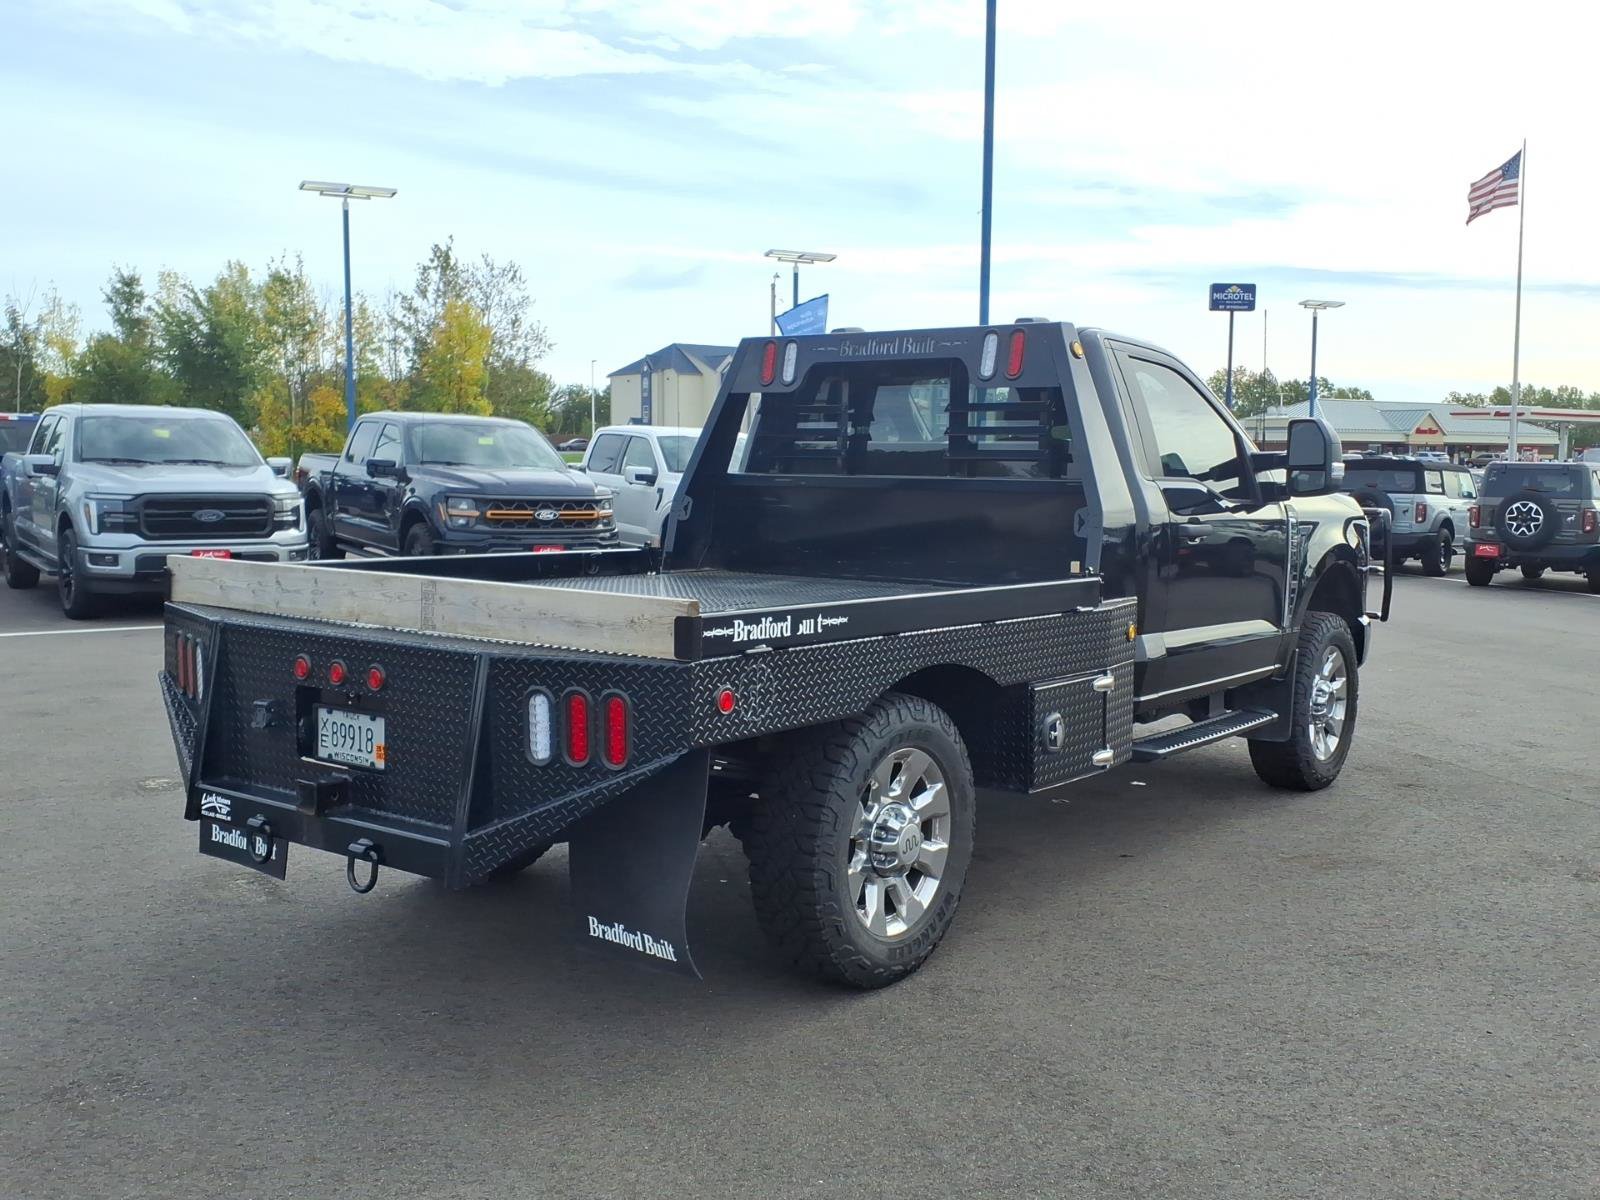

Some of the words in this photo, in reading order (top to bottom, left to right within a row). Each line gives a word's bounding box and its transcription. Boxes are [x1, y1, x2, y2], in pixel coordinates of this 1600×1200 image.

[1213, 292, 1254, 301] MICROTEL
[839, 337, 899, 357] Bradford
[902, 336, 936, 354] Built
[732, 615, 791, 642] Bradford
[331, 721, 374, 754] 89918
[334, 751, 369, 764] WISCONSIN
[255, 836, 277, 860] But
[587, 916, 644, 952] Bradford
[643, 933, 677, 962] Built
